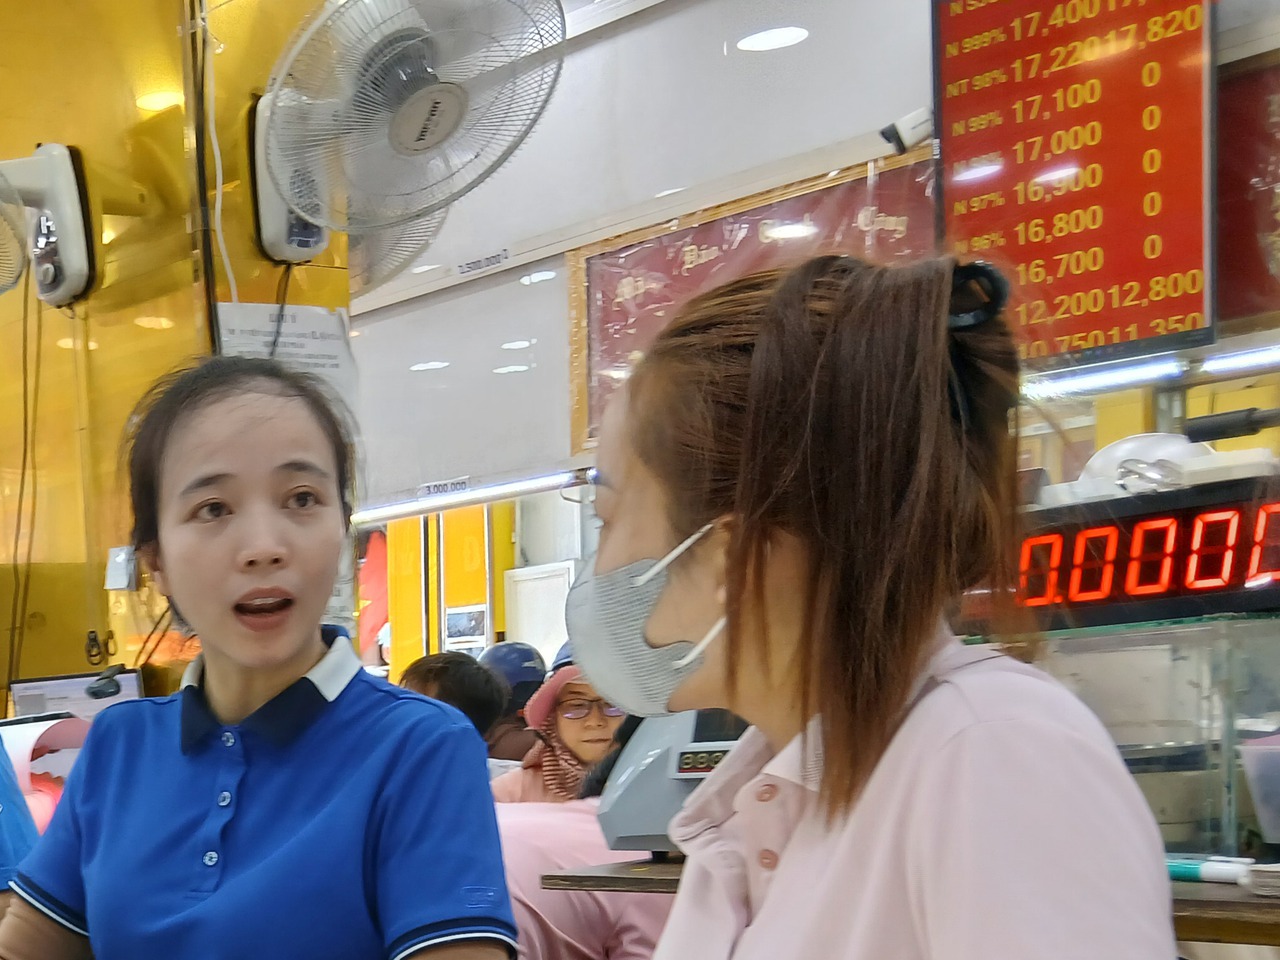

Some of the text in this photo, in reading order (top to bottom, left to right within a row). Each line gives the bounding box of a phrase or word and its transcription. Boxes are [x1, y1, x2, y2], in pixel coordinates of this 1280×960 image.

[1010, 0, 1101, 41] 17,400
[1010, 36, 1100, 82] 17,220
[1104, 4, 1203, 55] 17,820
[1011, 79, 1102, 123] 17,100
[1142, 61, 1161, 87] 0
[1012, 121, 1103, 164] 17,000
[1142, 105, 1162, 131] 0
[1013, 163, 1103, 205] 16,900
[1142, 148, 1162, 174] 0
[1014, 205, 1104, 246] 16,800
[1142, 191, 1162, 217] 0
[1015, 234, 1163, 286] 16,700 0
[1016, 269, 1204, 326] 12,200 12,800
[1017, 312, 1204, 360] 10750 11350
[426, 481, 467, 495] 3.000.000
